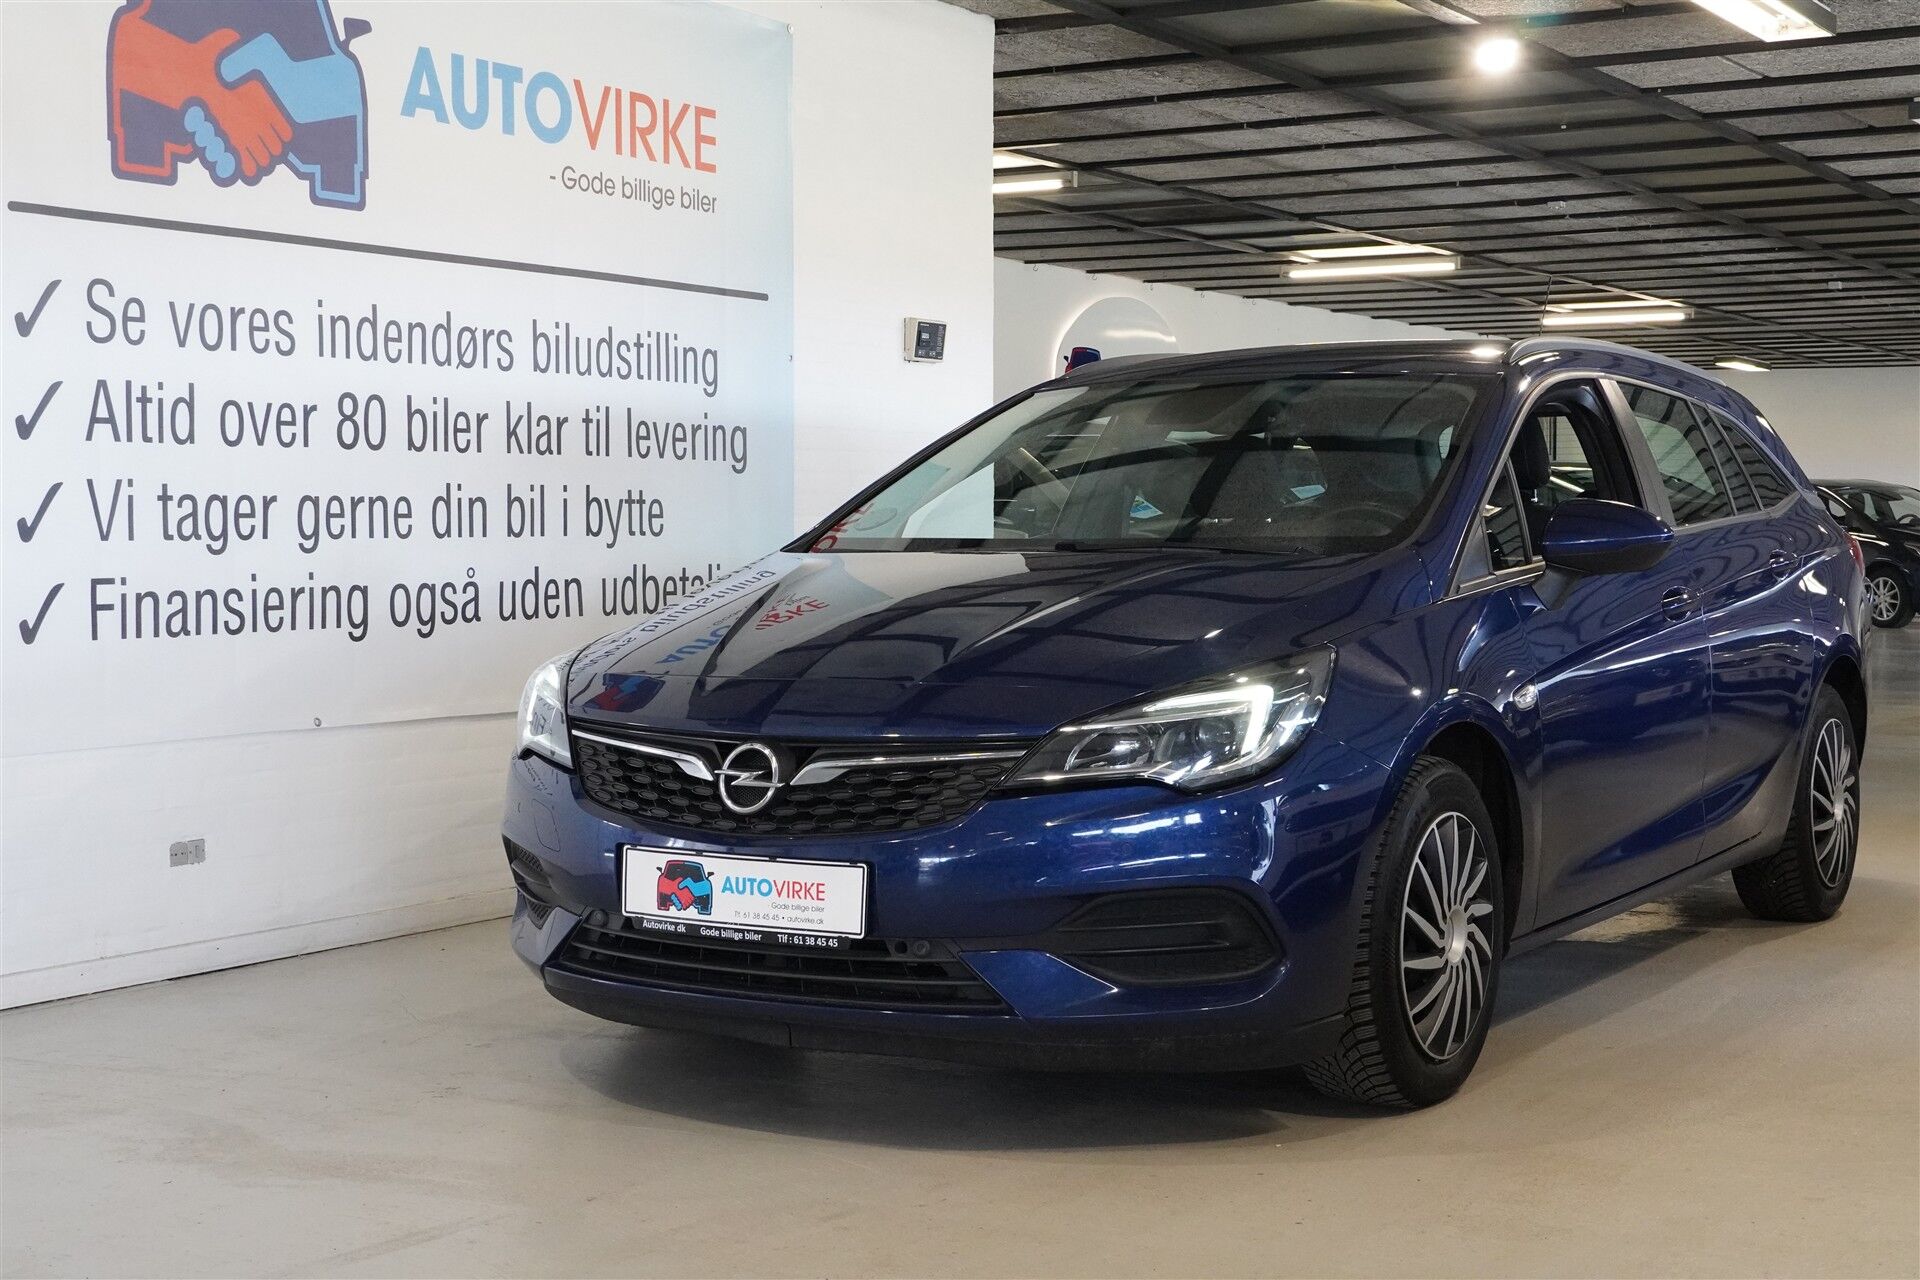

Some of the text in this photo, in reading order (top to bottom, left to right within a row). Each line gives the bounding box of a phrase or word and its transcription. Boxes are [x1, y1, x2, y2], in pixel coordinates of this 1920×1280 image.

[400, 46, 717, 174] AUTOVIRKE
[561, 166, 616, 197] Gode
[621, 176, 676, 211] billige
[680, 185, 718, 214] biler
[86, 278, 718, 397] Se vores indendørs biludstilling
[85, 379, 747, 474] Altid over 80 biler klar til levering
[86, 478, 664, 556] Vi tager gerne din bil i bytte
[90, 572, 368, 643] Finansiering
[390, 567, 481, 639] også
[499, 566, 583, 622] uden
[601, 563, 721, 617] udbet
[721, 875, 826, 902] AUTOVIRKE
[752, 912, 761, 920] 38
[762, 913, 770, 921] 45
[771, 914, 780, 922] 45
[786, 915, 825, 925] autovirke.dk
[771, 902, 825, 913] Gode billige biler
[642, 920, 676, 932] Autovirke
[676, 923, 687, 933] dk
[700, 926, 720, 937] Gode
[721, 929, 743, 941] billige
[744, 930, 762, 941] biler
[793, 935, 804, 945] 61
[805, 936, 815, 946] 38
[816, 937, 827, 947] 45
[828, 938, 838, 948] 45
